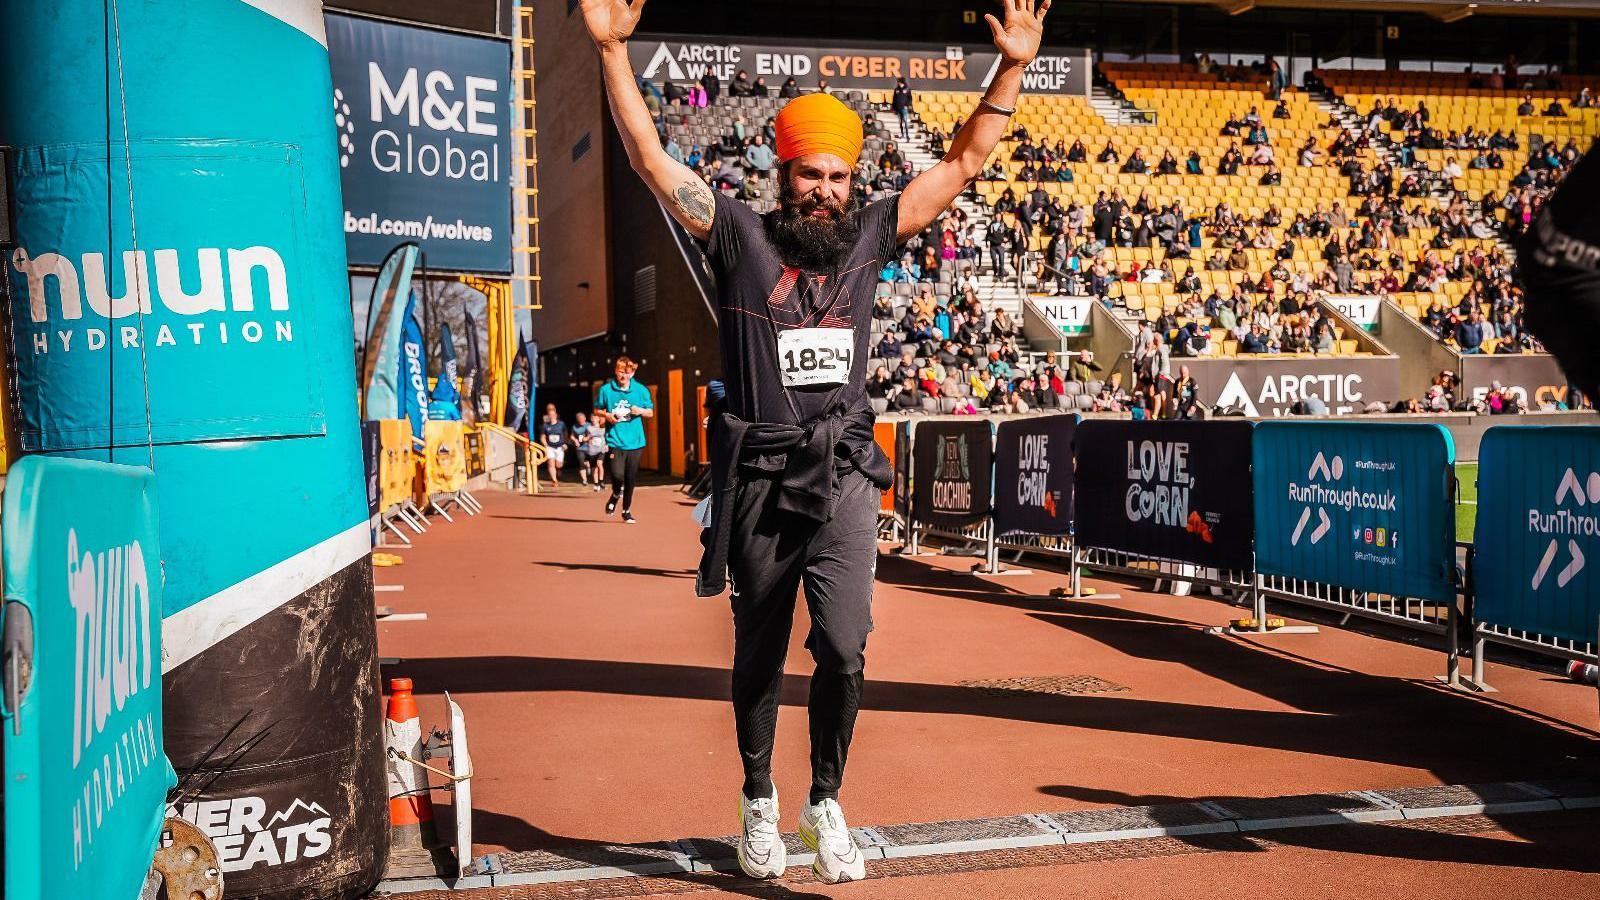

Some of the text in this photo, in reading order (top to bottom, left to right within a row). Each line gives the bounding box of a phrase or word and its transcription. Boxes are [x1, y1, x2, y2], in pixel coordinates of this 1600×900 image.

[678, 44, 741, 63] ARCTIC
[755, 53, 966, 81] END CYBER RISK
[368, 61, 498, 137] M&E
[1022, 73, 1067, 90] WOLF
[370, 129, 499, 182] Global
[12, 246, 290, 323] nuun
[1045, 305, 1077, 320] NL1
[33, 320, 293, 355] HYDRATION
[784, 347, 851, 373] 1824
[405, 342, 430, 438] BROOK
[1258, 374, 1363, 404] ARCTIC
[1018, 434, 1050, 473] LOVE,
[1127, 440, 1196, 490] LOVE,
[932, 480, 972, 510] COACHING
[1017, 471, 1047, 508] CORN
[1125, 483, 1189, 528] CORN
[1288, 482, 1396, 512] RunThrough.co.uk
[67, 527, 152, 770] nuun
[72, 711, 158, 872] HYDRATION
